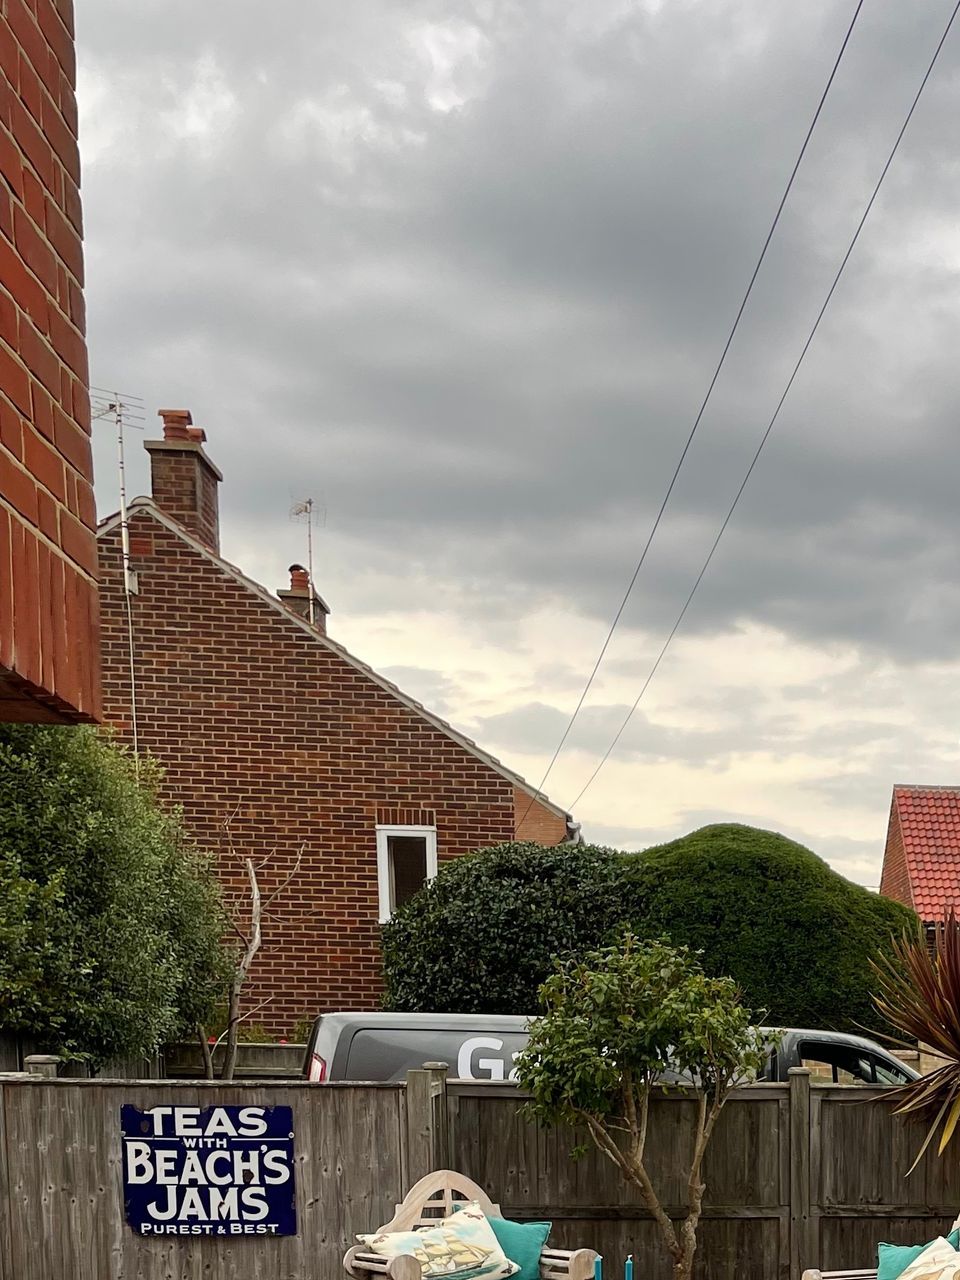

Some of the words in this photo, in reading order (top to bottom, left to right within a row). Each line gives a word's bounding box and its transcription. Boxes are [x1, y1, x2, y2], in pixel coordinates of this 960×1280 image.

[144, 1107, 268, 1137] TEAS
[182, 1137, 228, 1148] WITH
[126, 1141, 291, 1186] BEACH'S
[146, 1185, 270, 1222] JAMS
[140, 1222, 213, 1235] PUREST
[217, 1224, 227, 1235] &
[230, 1222, 280, 1235] BEST
